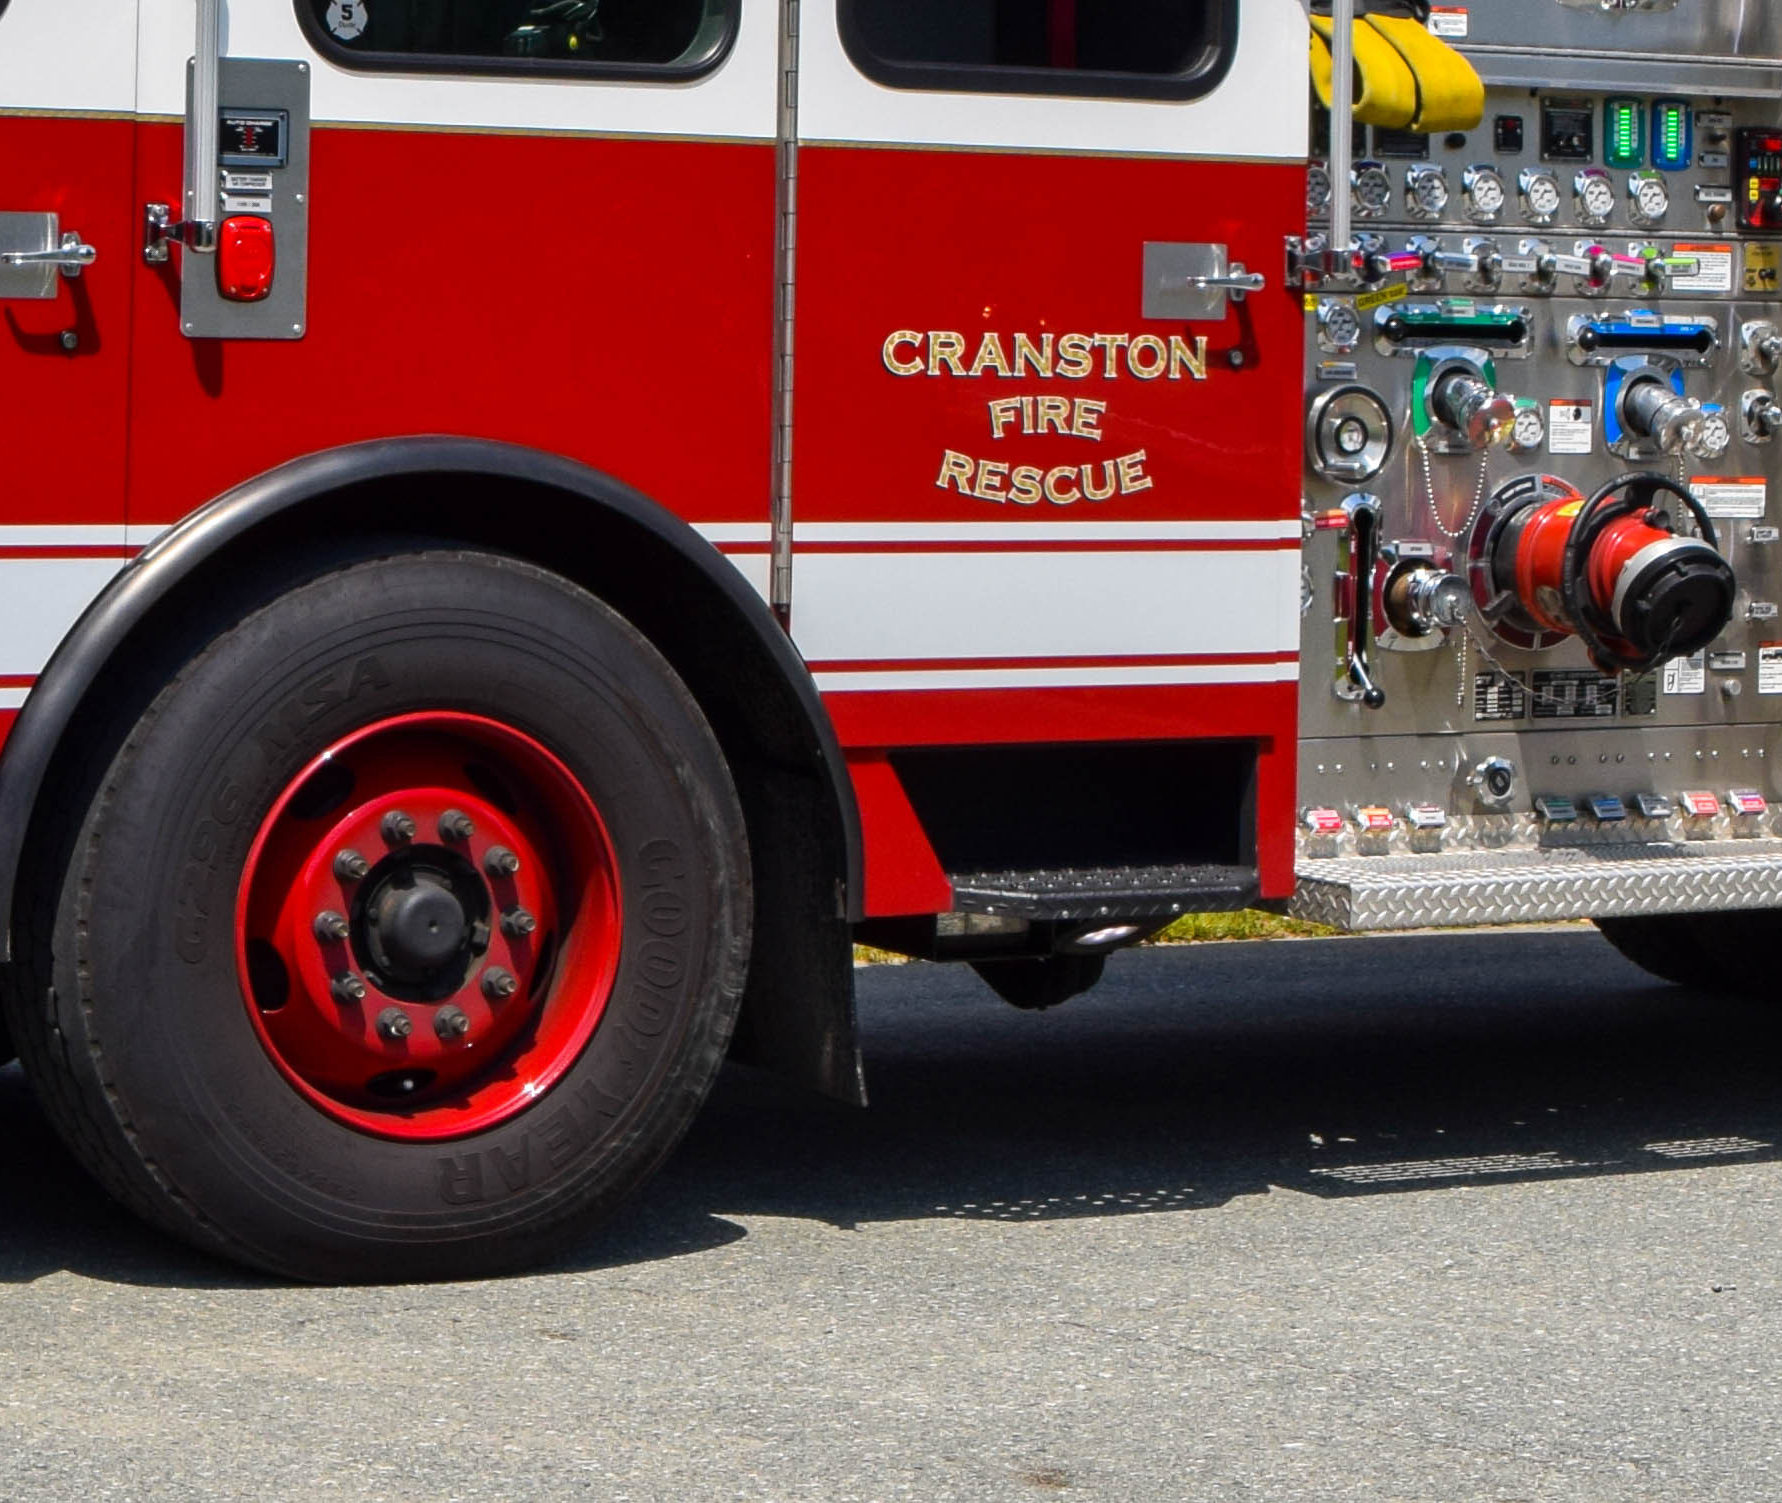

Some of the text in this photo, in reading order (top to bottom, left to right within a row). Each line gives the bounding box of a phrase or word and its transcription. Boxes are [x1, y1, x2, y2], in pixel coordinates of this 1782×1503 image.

[341, 3, 353, 21] 5
[882, 330, 1209, 380] CRANSTON
[987, 395, 1107, 441] FIRE
[936, 449, 1154, 505] RESCUE
